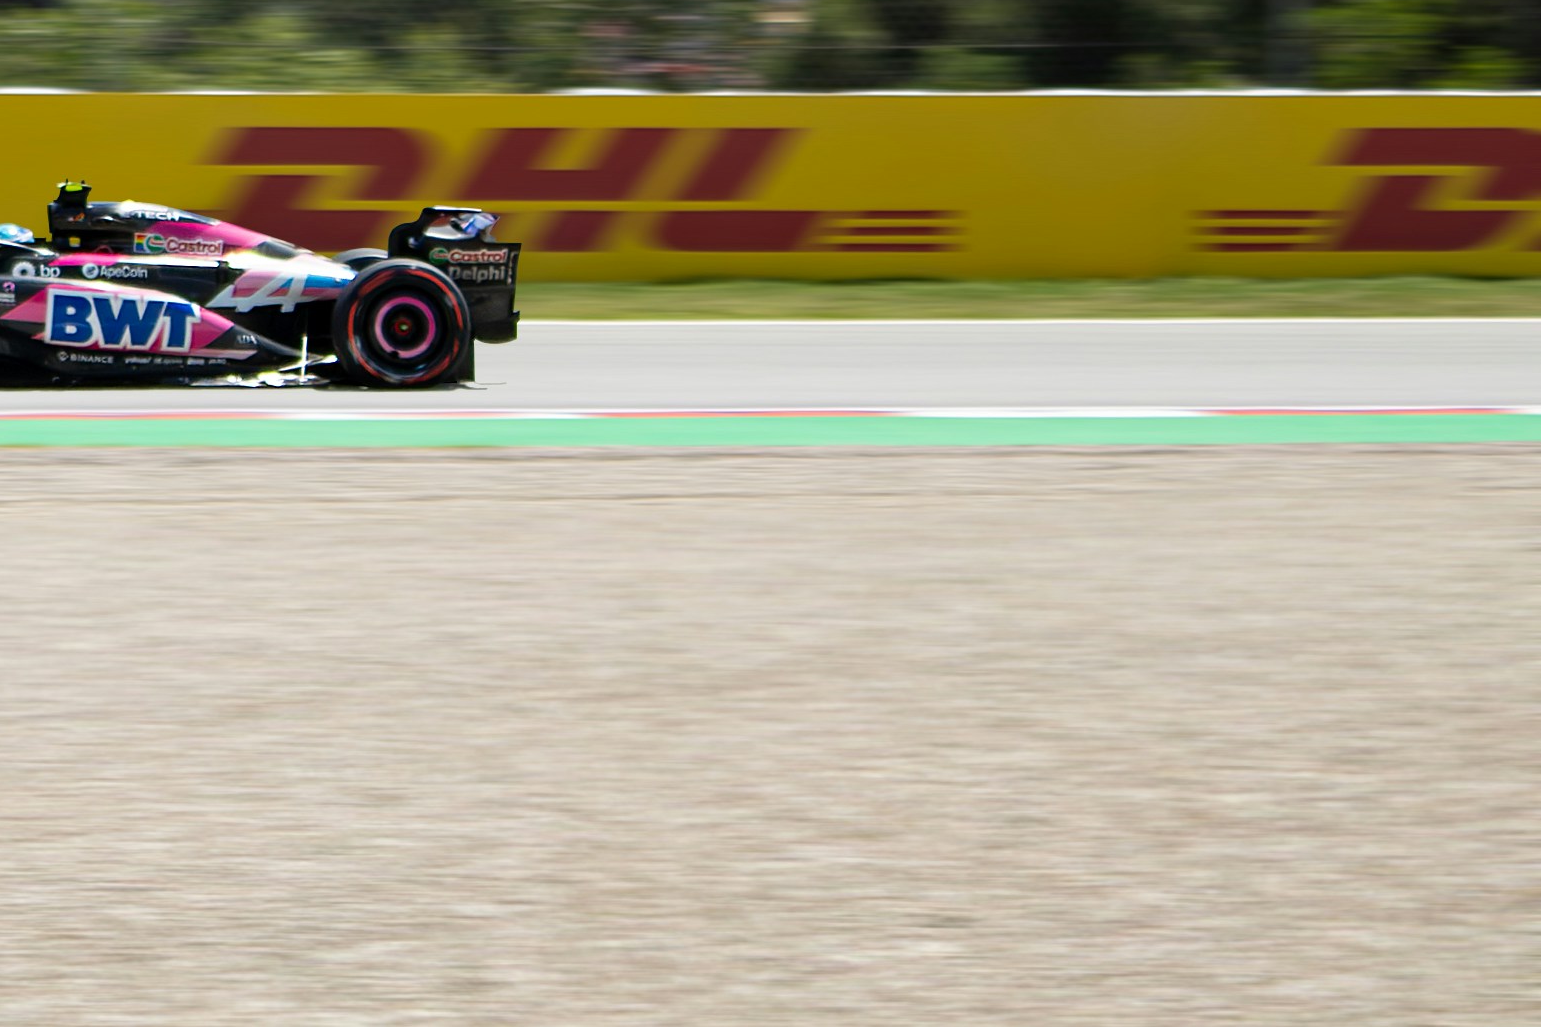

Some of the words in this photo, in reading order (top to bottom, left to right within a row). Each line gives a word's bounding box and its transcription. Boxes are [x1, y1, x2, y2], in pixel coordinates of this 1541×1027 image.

[202, 126, 808, 252] DHL
[165, 237, 223, 255] Castrol
[449, 248, 509, 264] Castrol
[40, 264, 61, 278] bp
[100, 266, 149, 279] ApeCoin
[449, 265, 506, 283] Delphi
[47, 290, 199, 351] BWT
[70, 353, 114, 364] BINANCE
